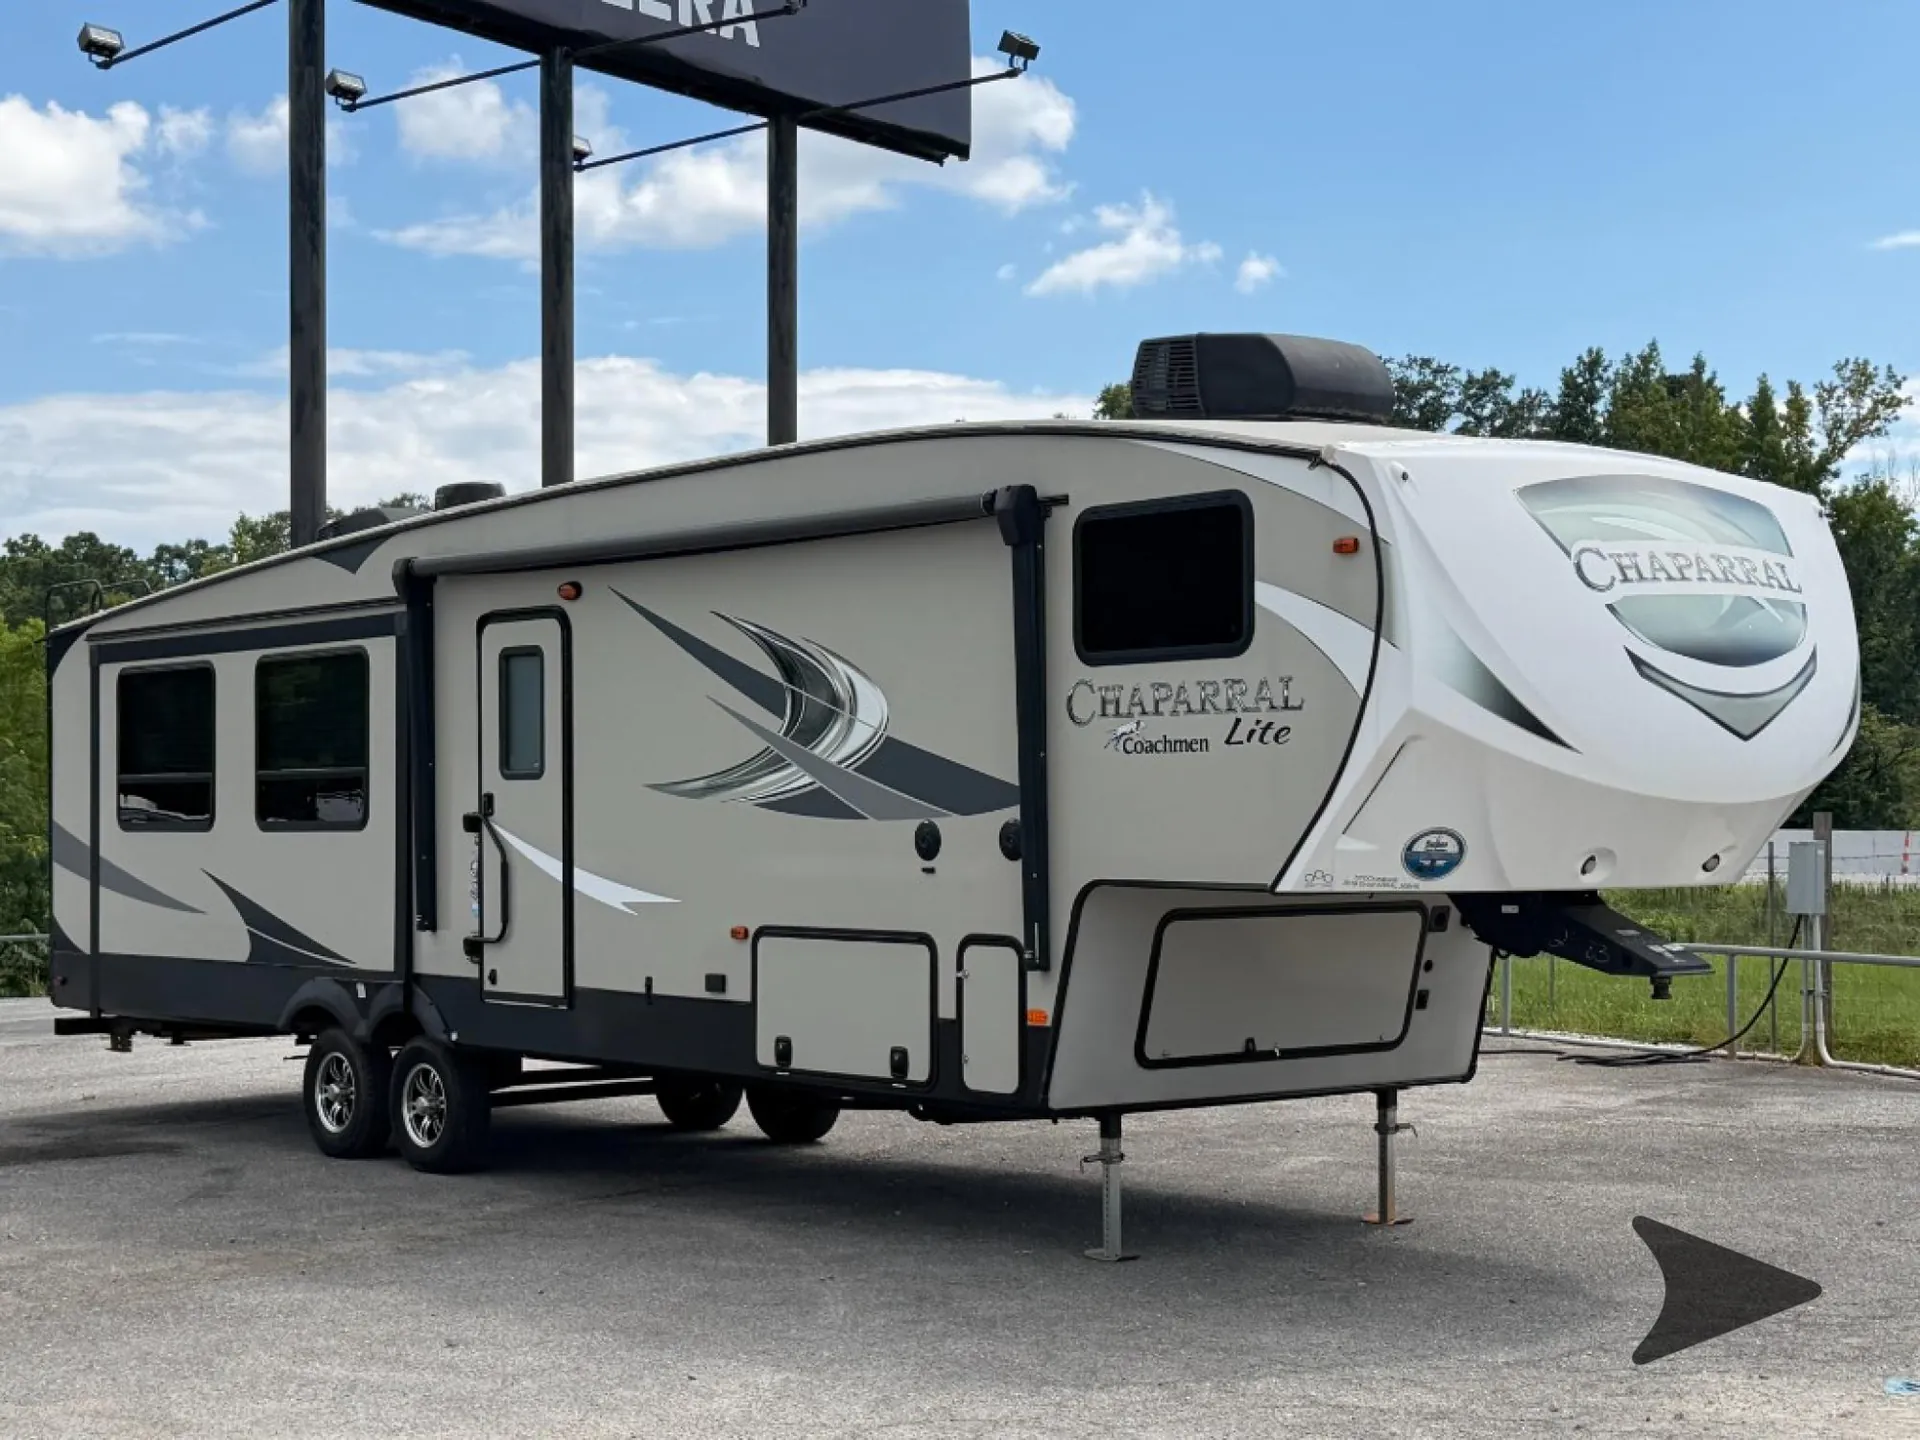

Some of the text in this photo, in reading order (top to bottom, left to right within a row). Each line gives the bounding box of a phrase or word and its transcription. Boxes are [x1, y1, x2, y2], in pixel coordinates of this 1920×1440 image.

[1572, 547, 1803, 593] CHAPARRAL
[1066, 675, 1305, 727] CHAPARRAL
[1122, 735, 1209, 755] Coachmen
[1223, 717, 1292, 746] Lite
